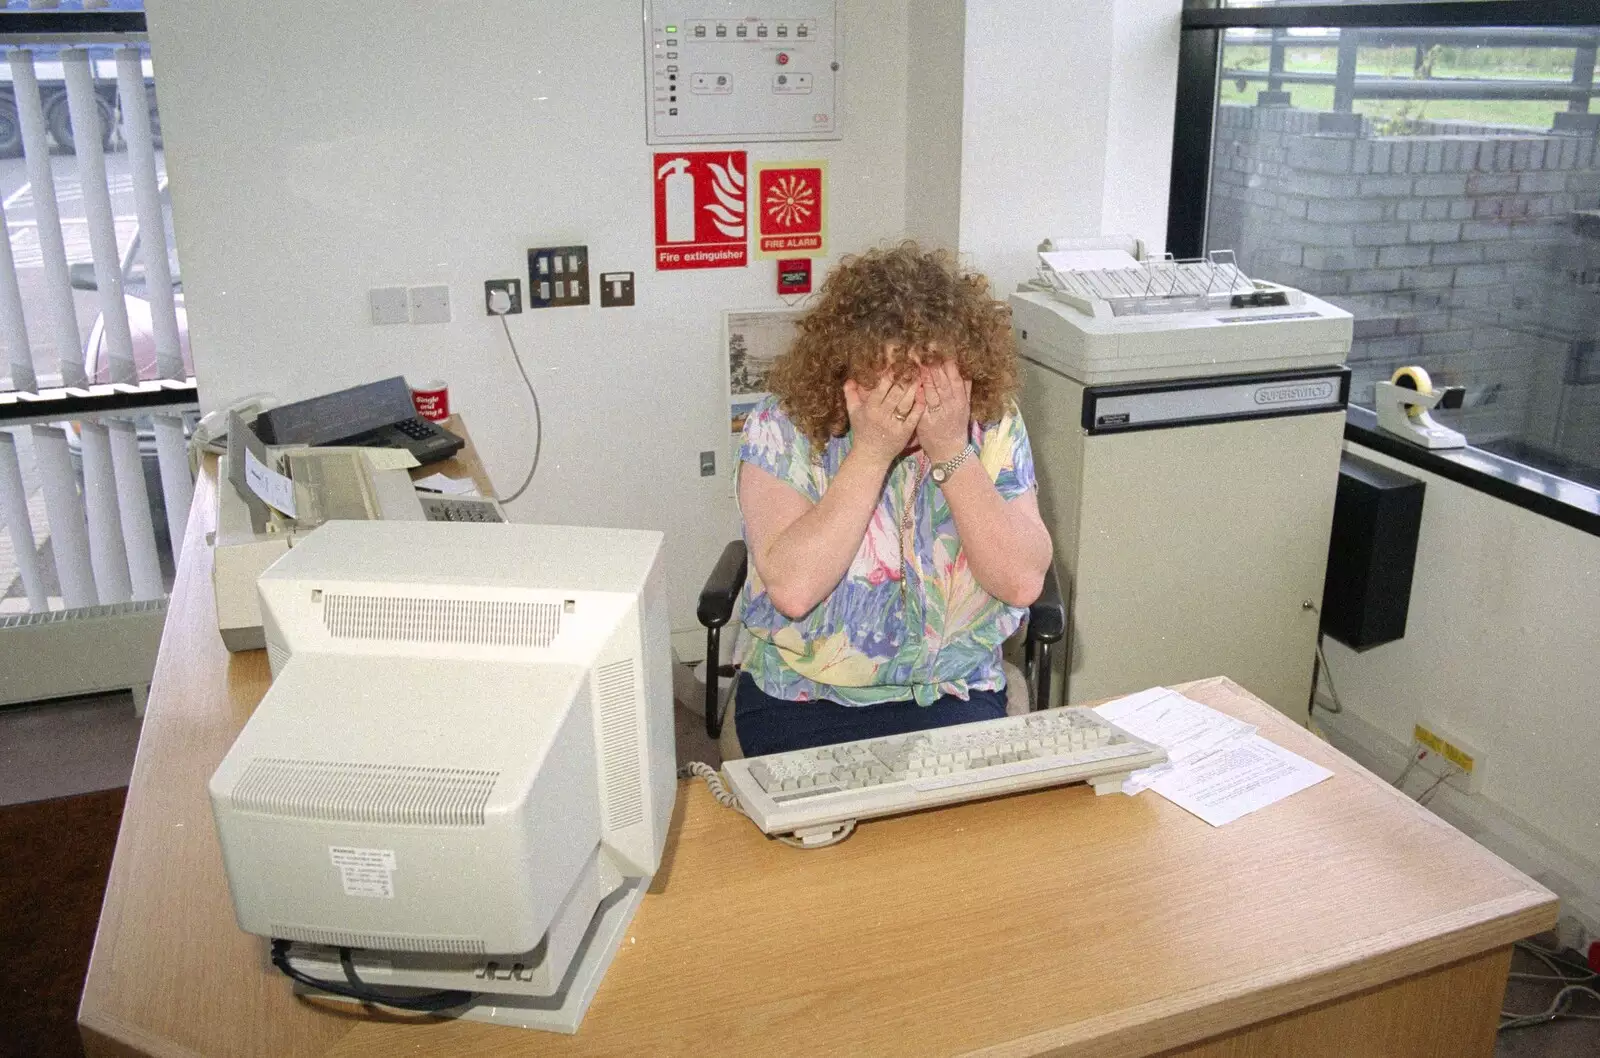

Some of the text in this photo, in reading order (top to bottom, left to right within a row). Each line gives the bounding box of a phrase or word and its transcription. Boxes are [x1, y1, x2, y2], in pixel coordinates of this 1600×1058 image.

[764, 238, 818, 249] FIRE ALARM
[659, 250, 744, 263] Fire extinguisher
[1259, 386, 1327, 402] SUPERSWITCH
[416, 396, 439, 404] Single
[418, 410, 437, 418] ving
